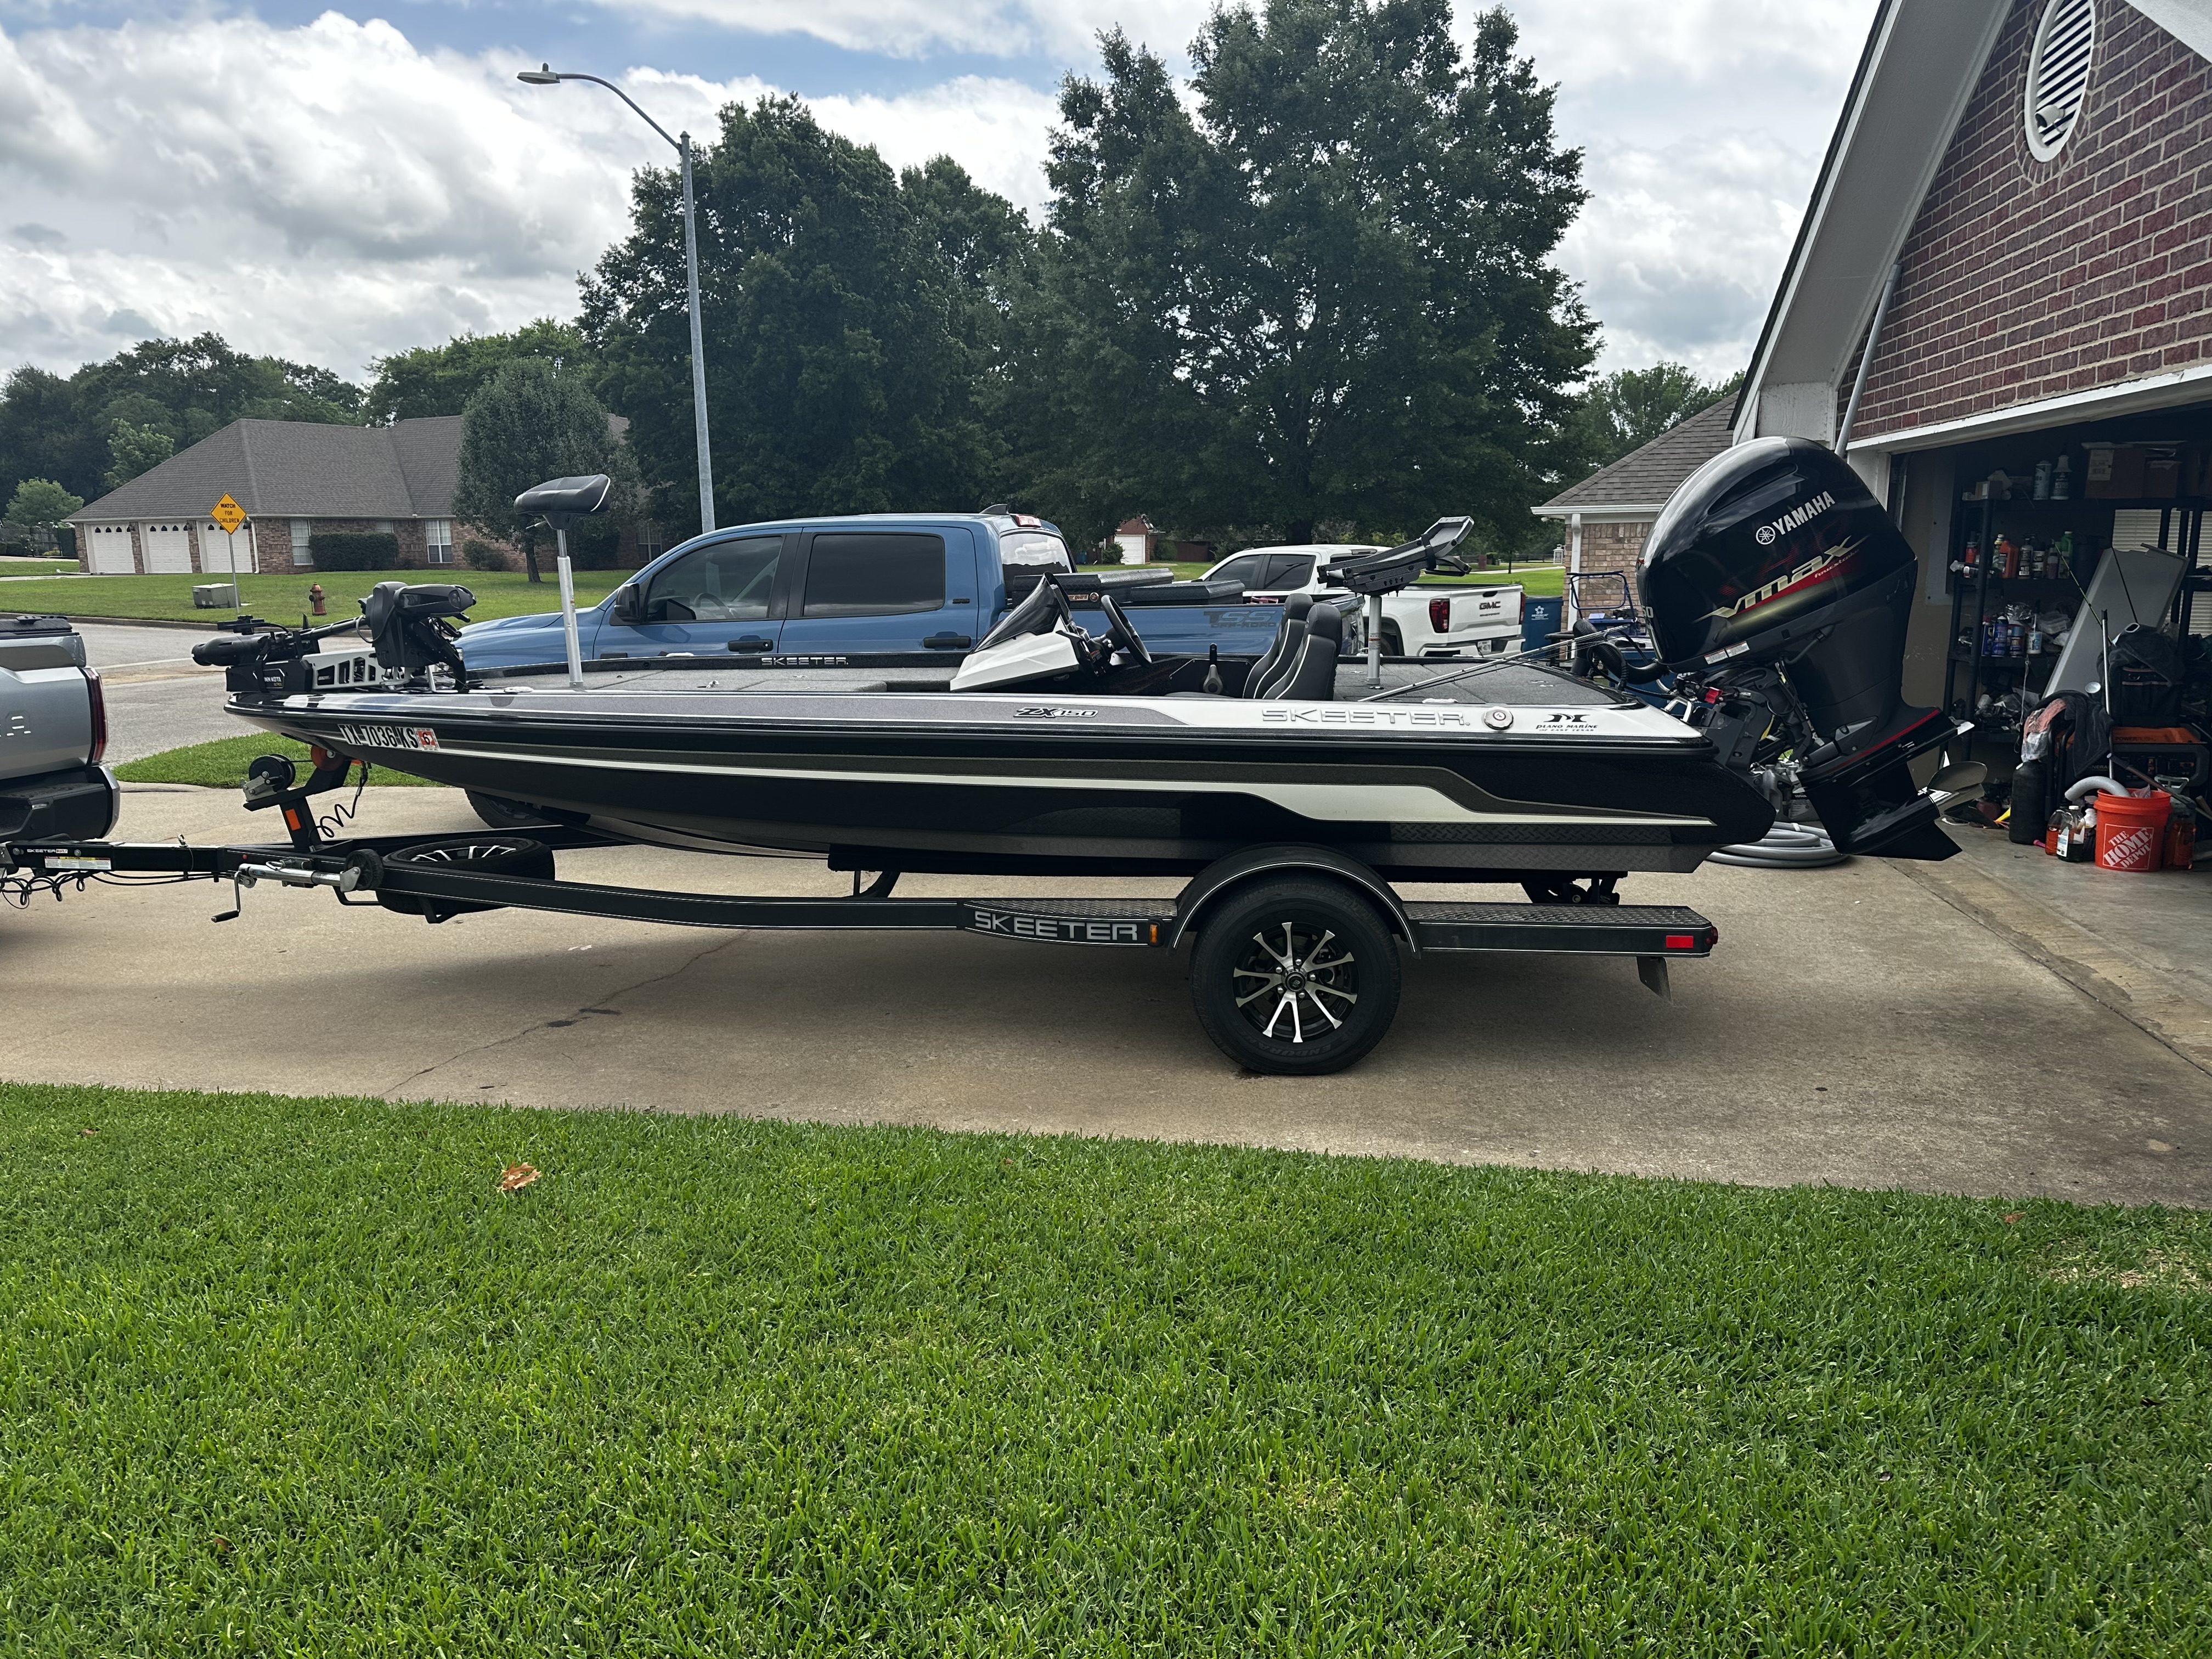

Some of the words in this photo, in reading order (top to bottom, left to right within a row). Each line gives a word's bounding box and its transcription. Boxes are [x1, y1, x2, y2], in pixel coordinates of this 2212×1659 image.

[1772, 491, 1835, 535] YAMAHA
[1479, 601, 1501, 610] GMC
[761, 657, 847, 665] SKEETER
[1262, 708, 1465, 725] SKEETER
[339, 725, 362, 745] TX
[360, 725, 398, 747] 7036
[396, 727, 419, 748] KS
[422, 732, 432, 746] 6
[2104, 827, 2152, 866] HOME
[2108, 831, 2129, 847] THE
[2120, 843, 2151, 868] DEPOT
[974, 911, 1137, 941] SKEETER
